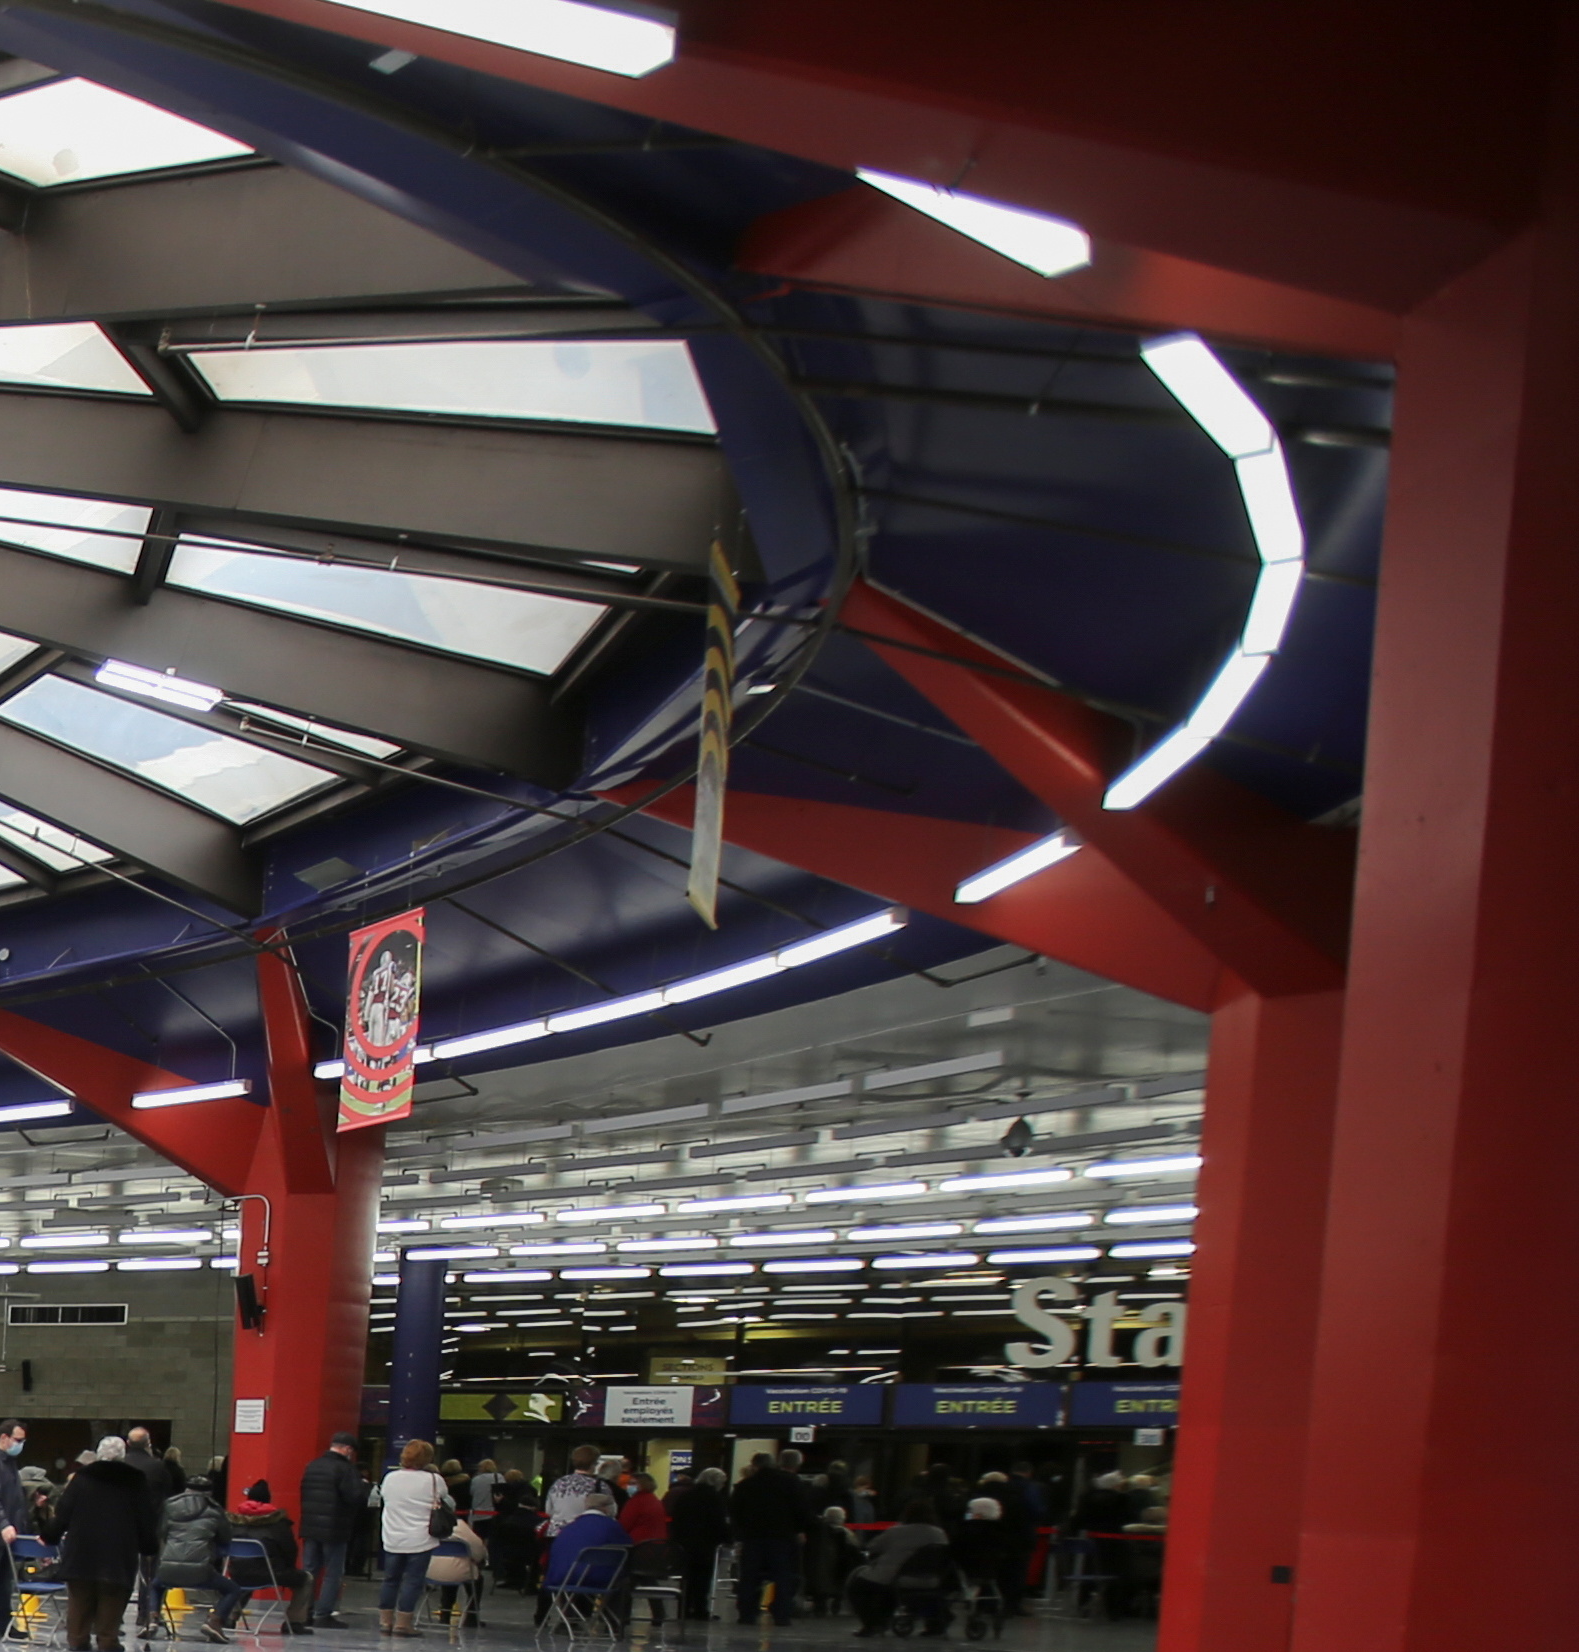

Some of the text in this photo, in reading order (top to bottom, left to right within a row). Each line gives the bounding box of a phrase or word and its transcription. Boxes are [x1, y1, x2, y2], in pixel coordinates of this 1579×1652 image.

[373, 969, 388, 995] 17
[389, 986, 408, 1012] 23
[1005, 1276, 1188, 1368] Sta
[632, 1397, 666, 1405] Entrée
[768, 1397, 843, 1413] ENTRÉE
[935, 1397, 1019, 1414] ENTRÉE
[623, 1407, 673, 1415] employés
[621, 1416, 676, 1424] seulement
